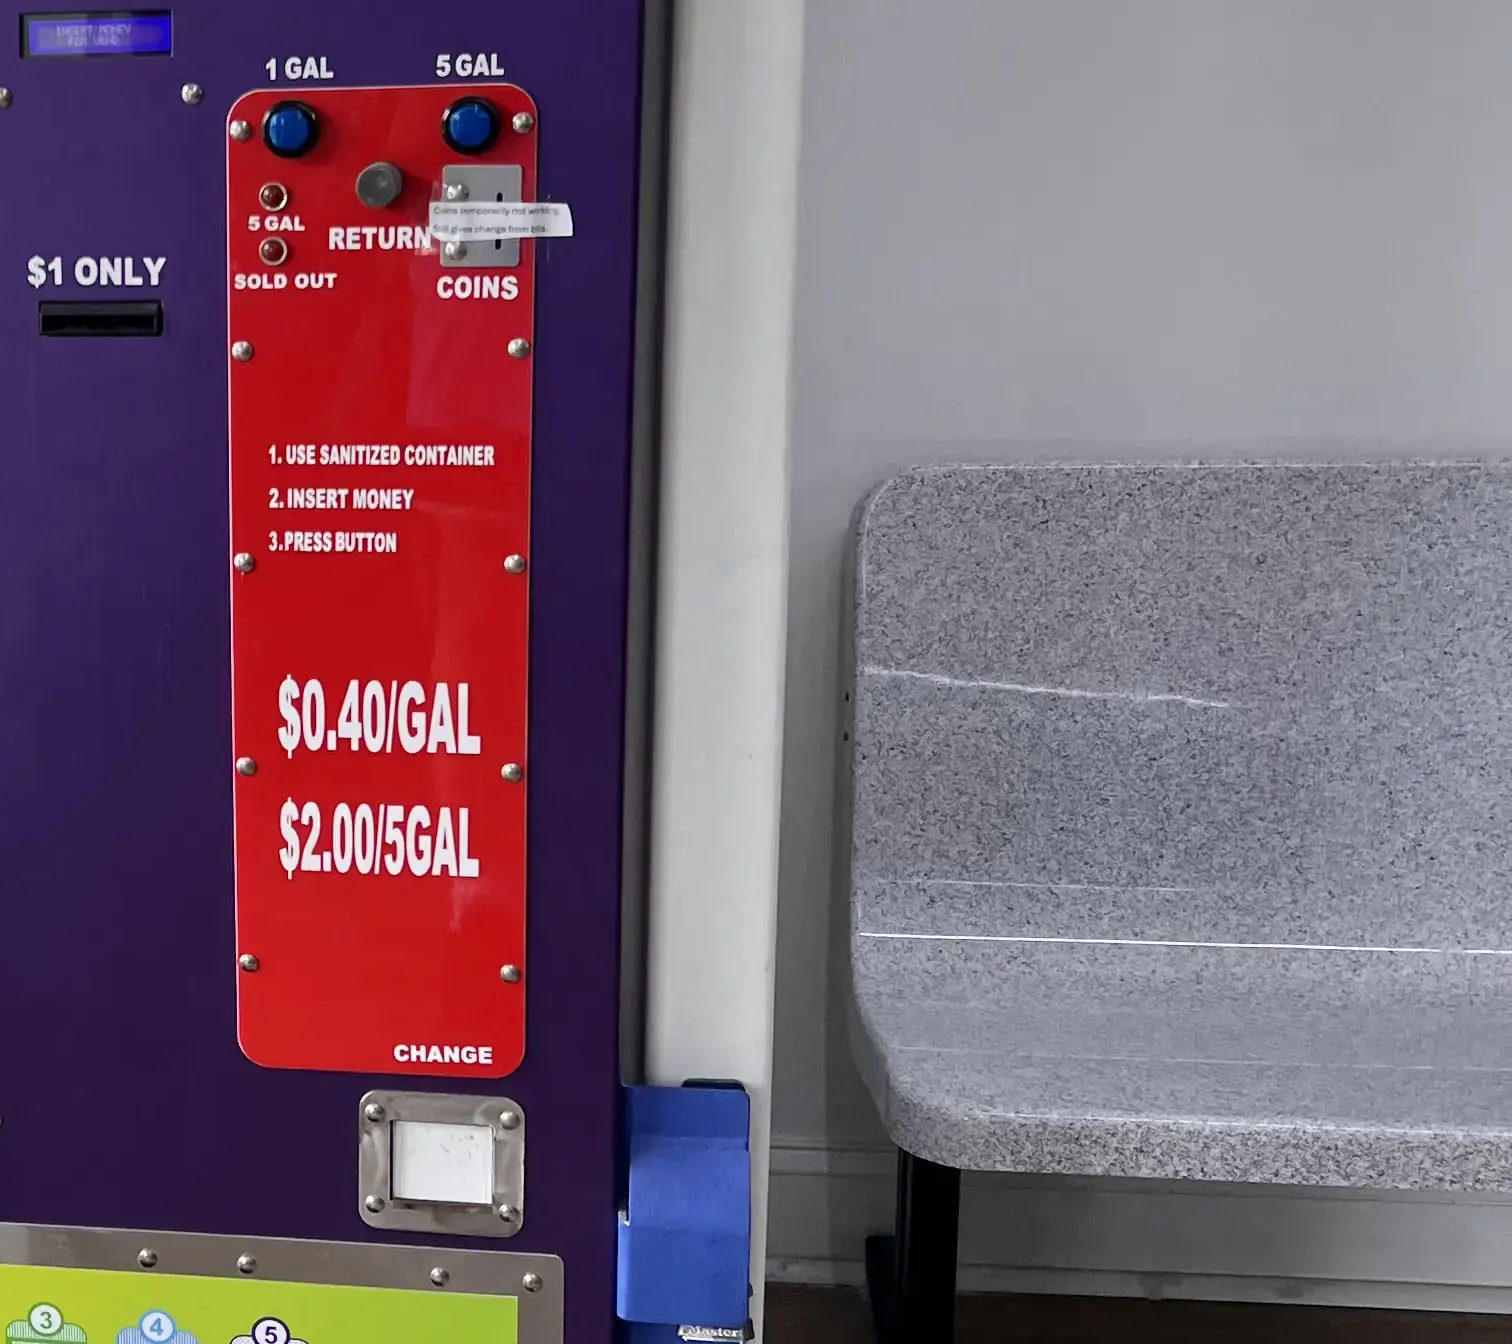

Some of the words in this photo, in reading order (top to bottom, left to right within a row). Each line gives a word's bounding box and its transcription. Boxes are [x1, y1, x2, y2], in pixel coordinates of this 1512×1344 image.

[265, 59, 276, 80] 1
[286, 57, 334, 80] GAL
[436, 55, 452, 77] 5
[455, 54, 504, 77] GAL
[460, 207, 510, 216] temporarily
[511, 207, 526, 215] not
[248, 216, 261, 232] 5
[264, 216, 306, 232] GAL
[450, 226, 473, 235] gives
[474, 225, 507, 235] change
[508, 225, 529, 233] from
[329, 226, 433, 250] RETURN
[27, 258, 63, 288] $1
[75, 256, 167, 287] ONLY
[234, 273, 288, 290] SOLD
[294, 272, 338, 290] OUT
[436, 276, 519, 299] COINS
[268, 444, 282, 464] 1.
[286, 445, 316, 465] USE
[319, 445, 400, 466] SANITIZED
[404, 445, 495, 466] CONTAINER
[268, 488, 284, 509] 2.
[287, 488, 348, 509] INSERT
[353, 489, 414, 510] MONEY
[284, 532, 333, 552] PRESS
[335, 532, 397, 553] BUTTON
[278, 674, 481, 758] $0.40/GAL
[279, 797, 480, 879] $2.00/5GAL
[393, 1044, 493, 1065] CHANGE
[39, 1311, 52, 1329] 3
[149, 1317, 163, 1336] 4
[264, 1326, 278, 1344] 5
